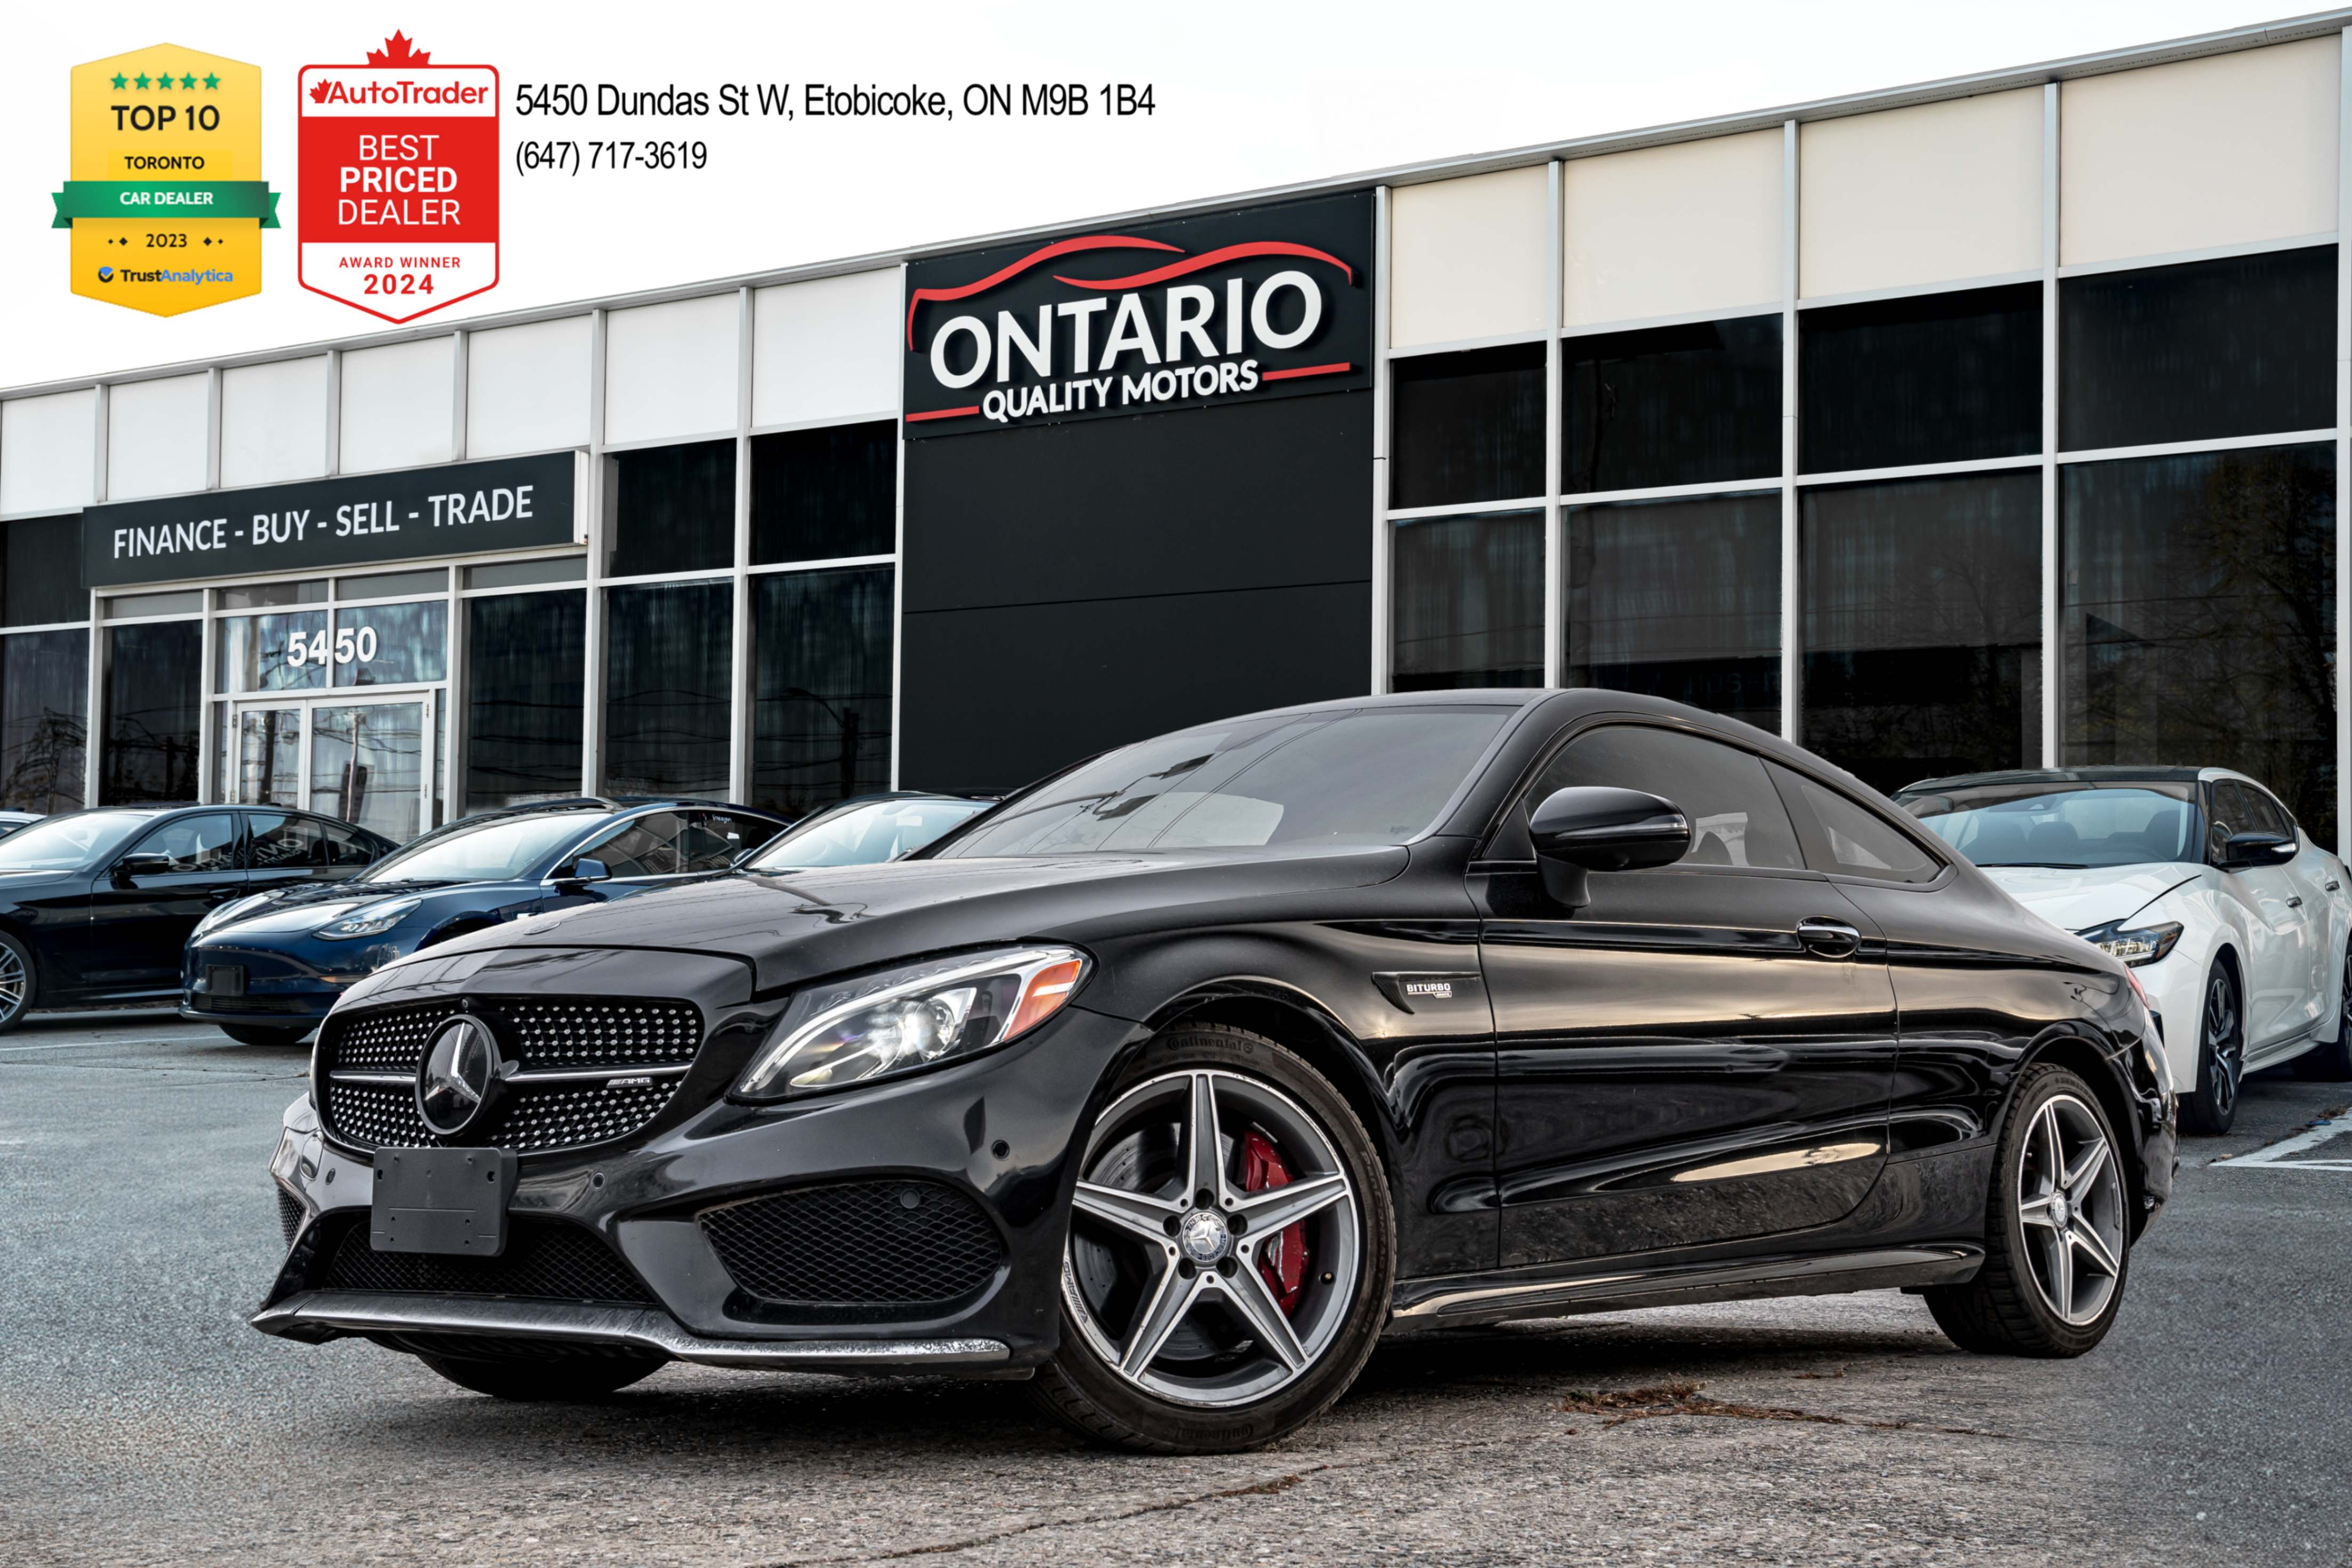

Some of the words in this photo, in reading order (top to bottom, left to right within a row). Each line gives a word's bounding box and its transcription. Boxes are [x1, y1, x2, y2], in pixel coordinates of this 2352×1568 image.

[930, 270, 1322, 389] ONTARIO
[982, 375, 1113, 423] QUALITY
[1122, 359, 1258, 406] MOTORS
[114, 518, 227, 559] FINANCE
[253, 510, 310, 545] BUY
[336, 500, 400, 537] SELL
[428, 485, 533, 527] TRADE
[287, 626, 377, 667] 5450
[1406, 983, 1451, 992] BITURBO
